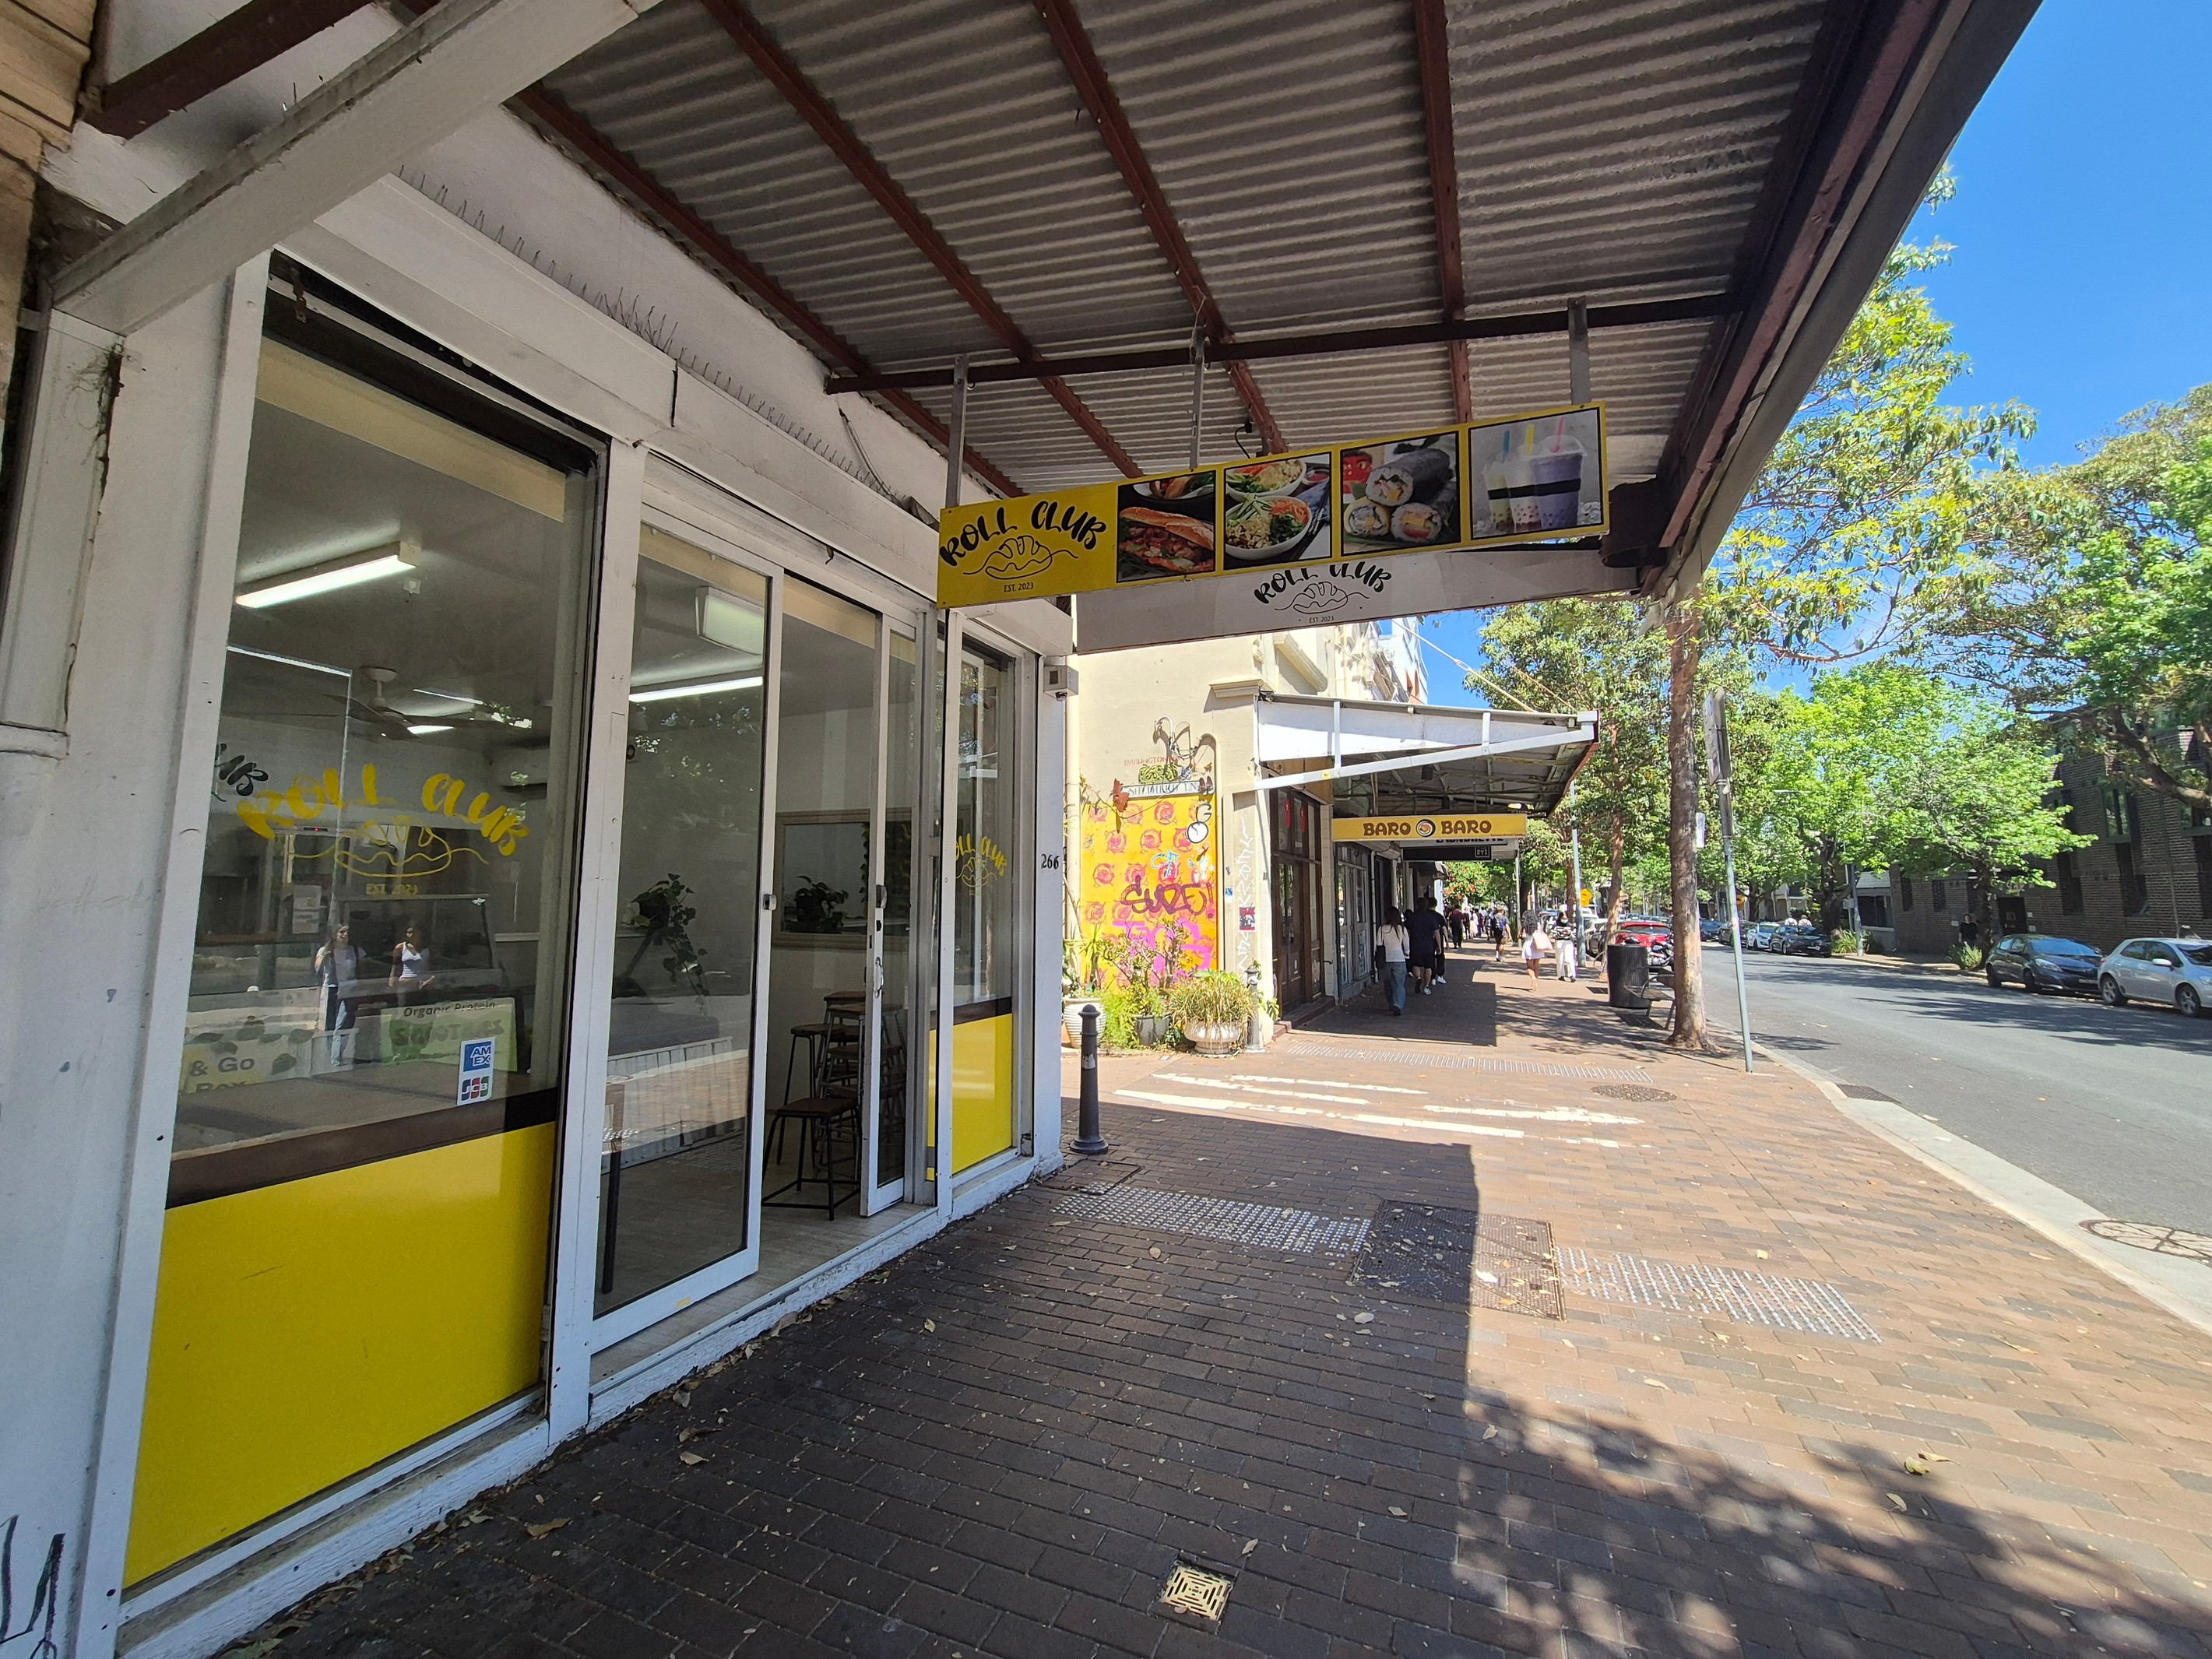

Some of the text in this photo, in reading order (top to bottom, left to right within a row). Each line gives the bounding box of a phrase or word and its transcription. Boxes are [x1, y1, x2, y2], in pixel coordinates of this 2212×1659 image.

[939, 501, 1107, 567] ROLL CLUB
[1018, 582, 1034, 592] 2023
[1254, 568, 1318, 604] ROLL
[237, 762, 530, 856] ROLL CLUB
[1363, 820, 1492, 835] BARO BARO
[980, 835, 1008, 877] CLUB
[1040, 853, 1060, 870] 266
[470, 1045, 492, 1057] AM
[188, 1056, 255, 1077] & Go
[461, 1081, 489, 1095] JCB
